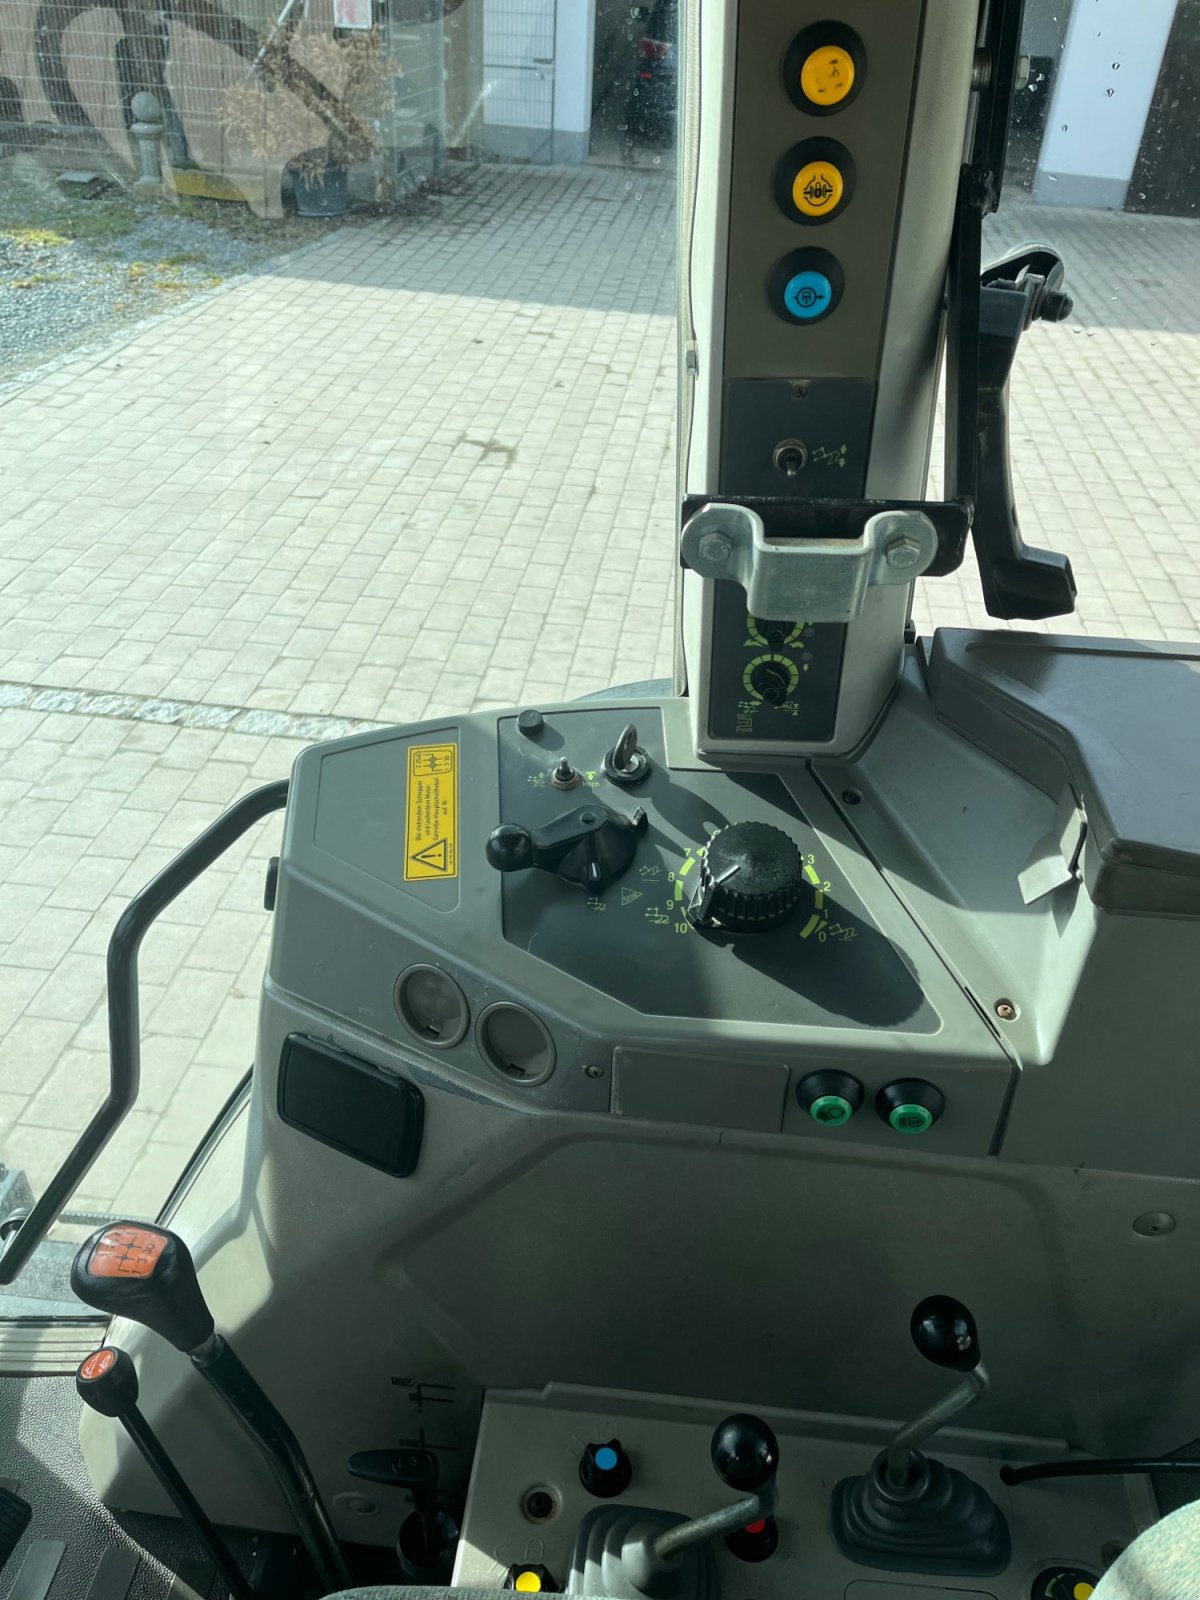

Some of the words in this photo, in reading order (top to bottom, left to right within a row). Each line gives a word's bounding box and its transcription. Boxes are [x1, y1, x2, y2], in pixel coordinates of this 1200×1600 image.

[684, 847, 692, 858] 7
[808, 854, 815, 864] 3
[668, 872, 676, 882] 8
[823, 881, 831, 892] 2
[666, 900, 674, 911] 9
[674, 922, 688, 934] 10
[818, 931, 826, 942] 0
